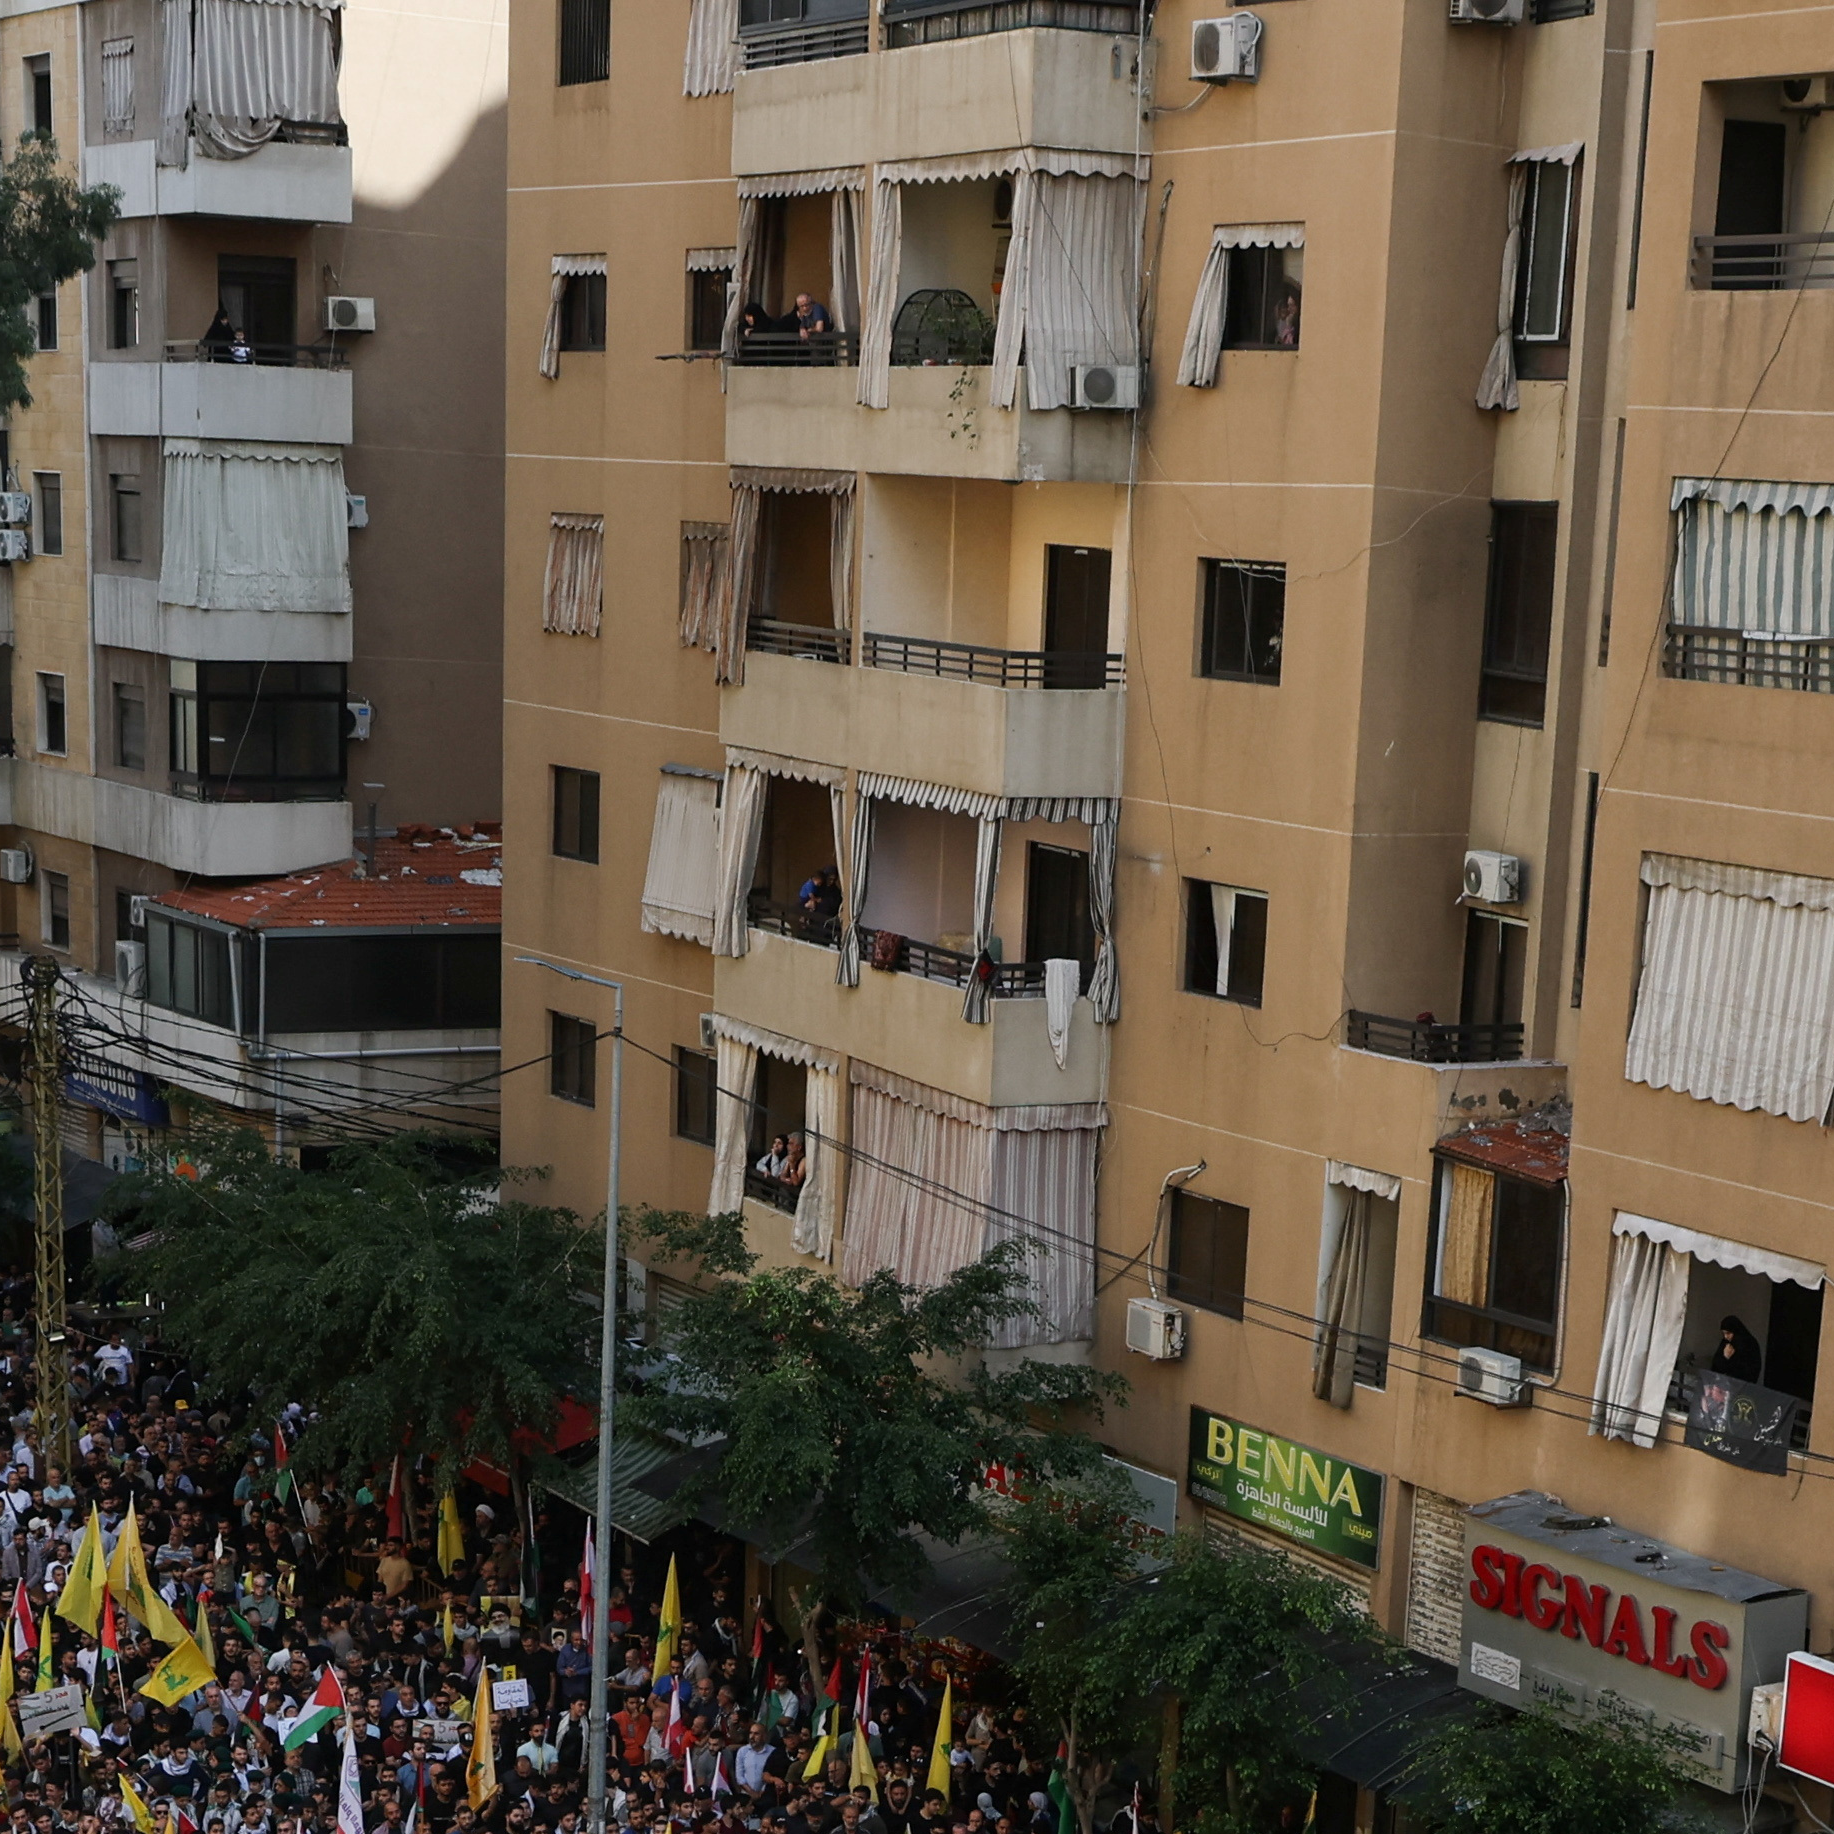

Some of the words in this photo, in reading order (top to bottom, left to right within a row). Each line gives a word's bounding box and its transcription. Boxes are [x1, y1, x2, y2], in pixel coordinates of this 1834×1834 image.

[1206, 1416, 1363, 1517] BENNA
[1236, 1479, 1281, 1509] الجاهزة
[1282, 1497, 1328, 1528] للألبسة
[1348, 1522, 1373, 1540] صيني
[1469, 1543, 1730, 1691] SIGNALS
[43, 1691, 53, 1704] 5
